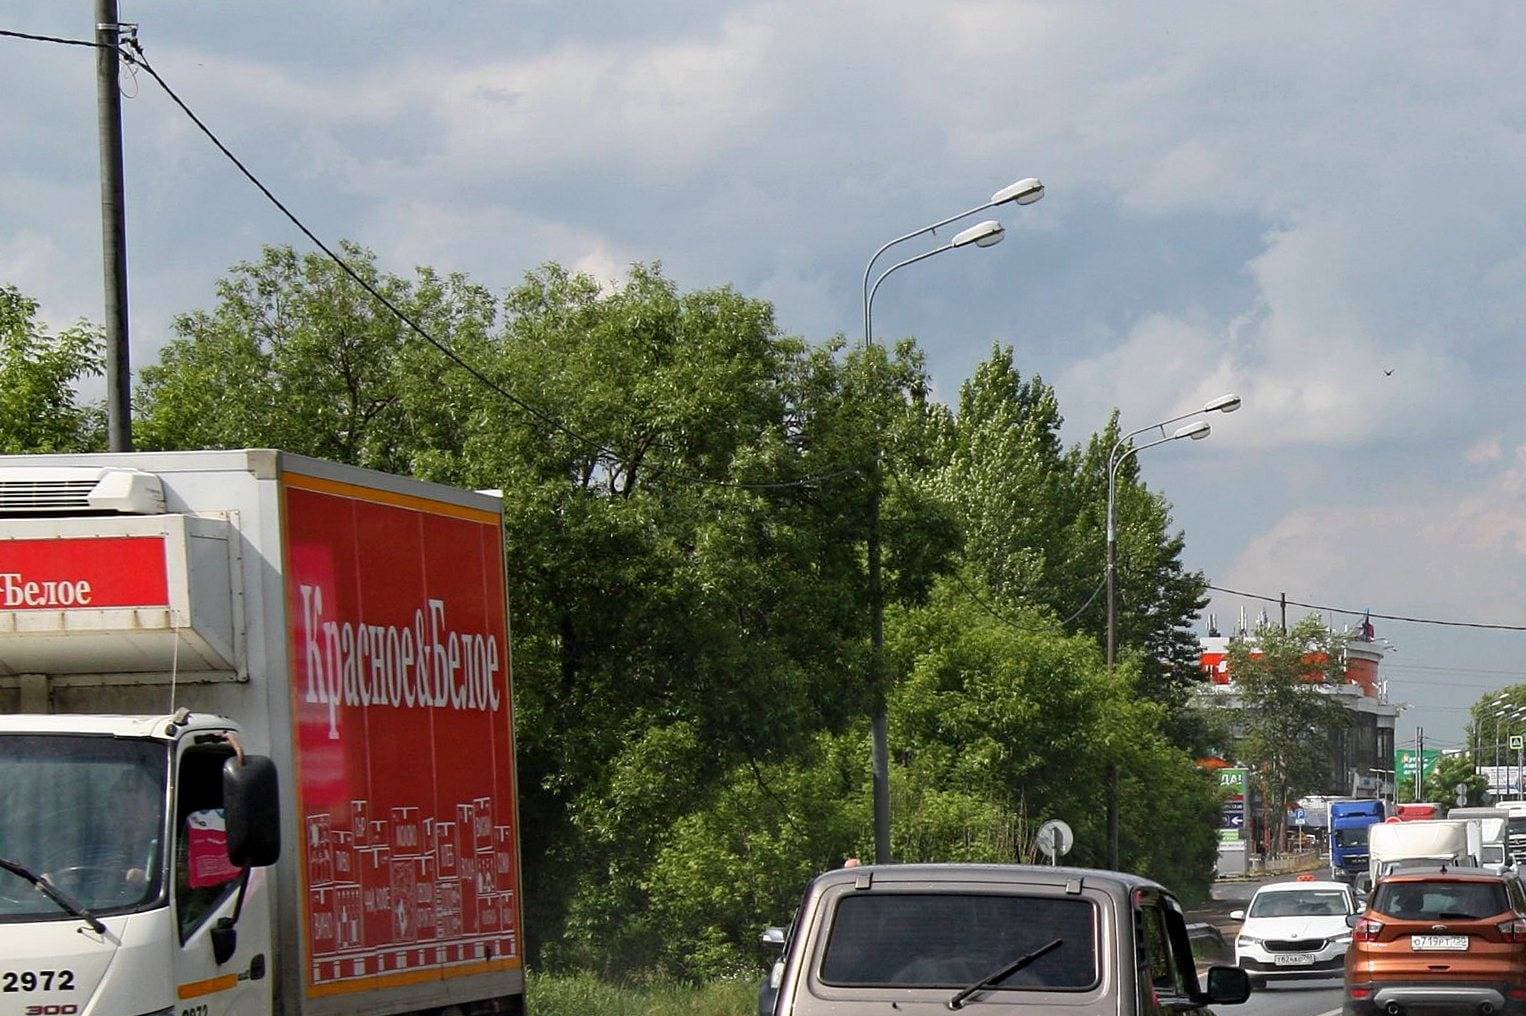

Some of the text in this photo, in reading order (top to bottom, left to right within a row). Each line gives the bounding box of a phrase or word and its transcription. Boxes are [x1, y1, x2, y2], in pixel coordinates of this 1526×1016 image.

[301, 585, 501, 740] Красное&Белое
[3, 970, 75, 992] 2972
[25, 1004, 78, 1016] 300
